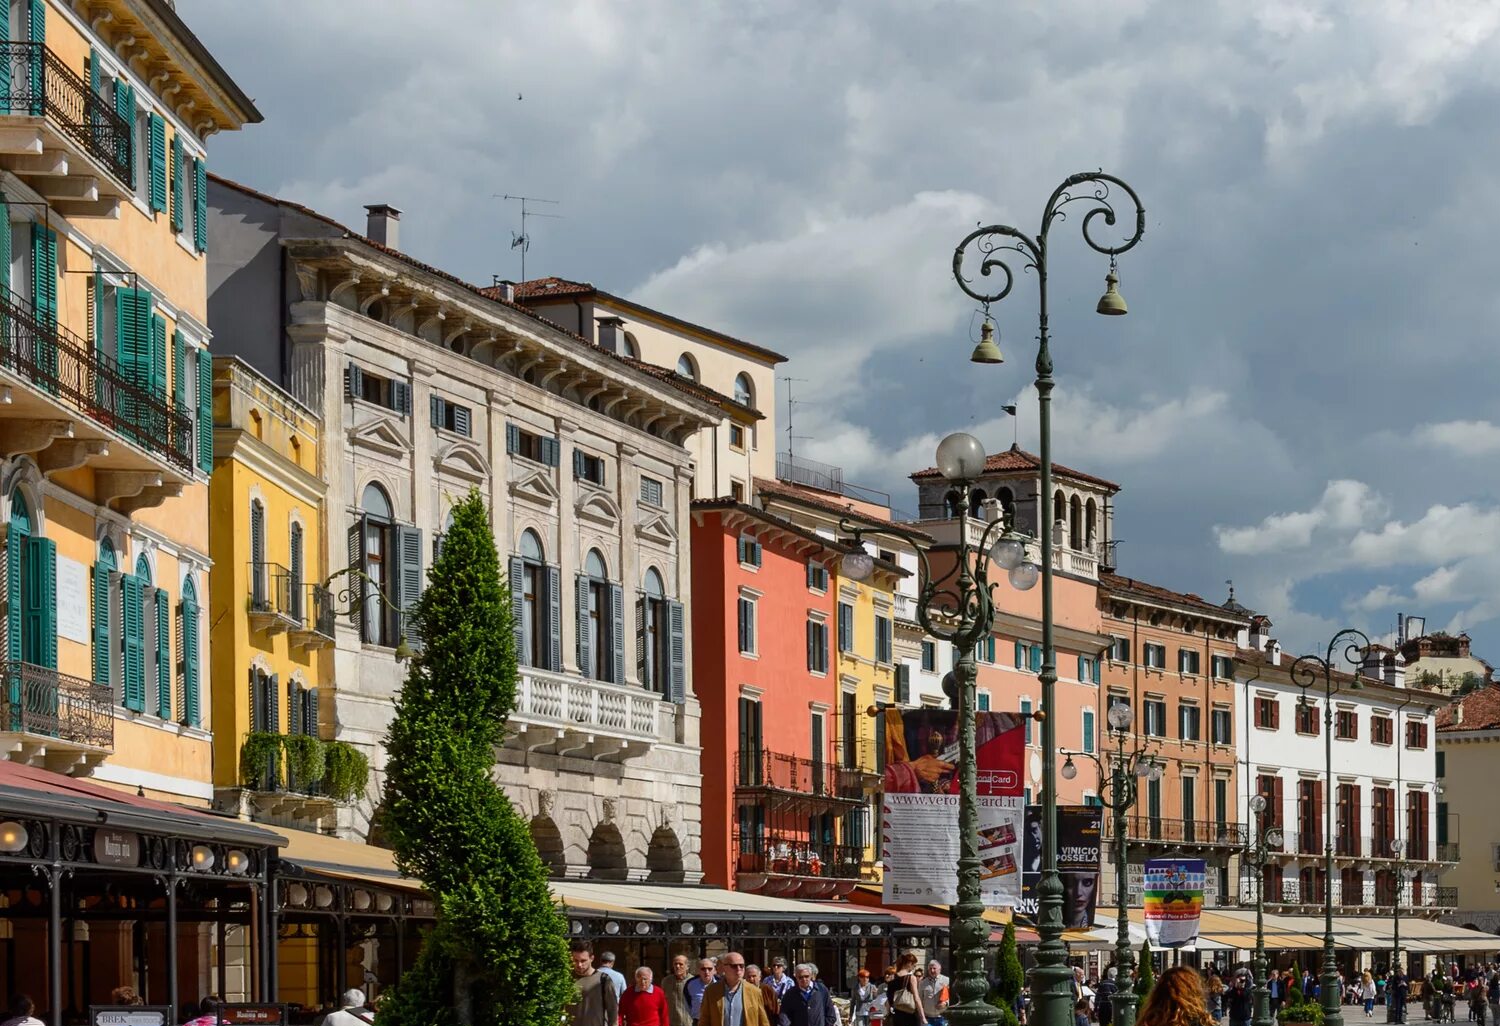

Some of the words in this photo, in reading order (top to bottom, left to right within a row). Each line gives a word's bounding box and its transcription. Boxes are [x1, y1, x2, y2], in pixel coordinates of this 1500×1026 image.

[892, 795, 1016, 808] www.verocard.it
[1090, 820, 1101, 829] 21
[1062, 846, 1099, 855] VINICIO
[1056, 854, 1098, 862] POSSELA
[102, 1015, 127, 1024] BREK
